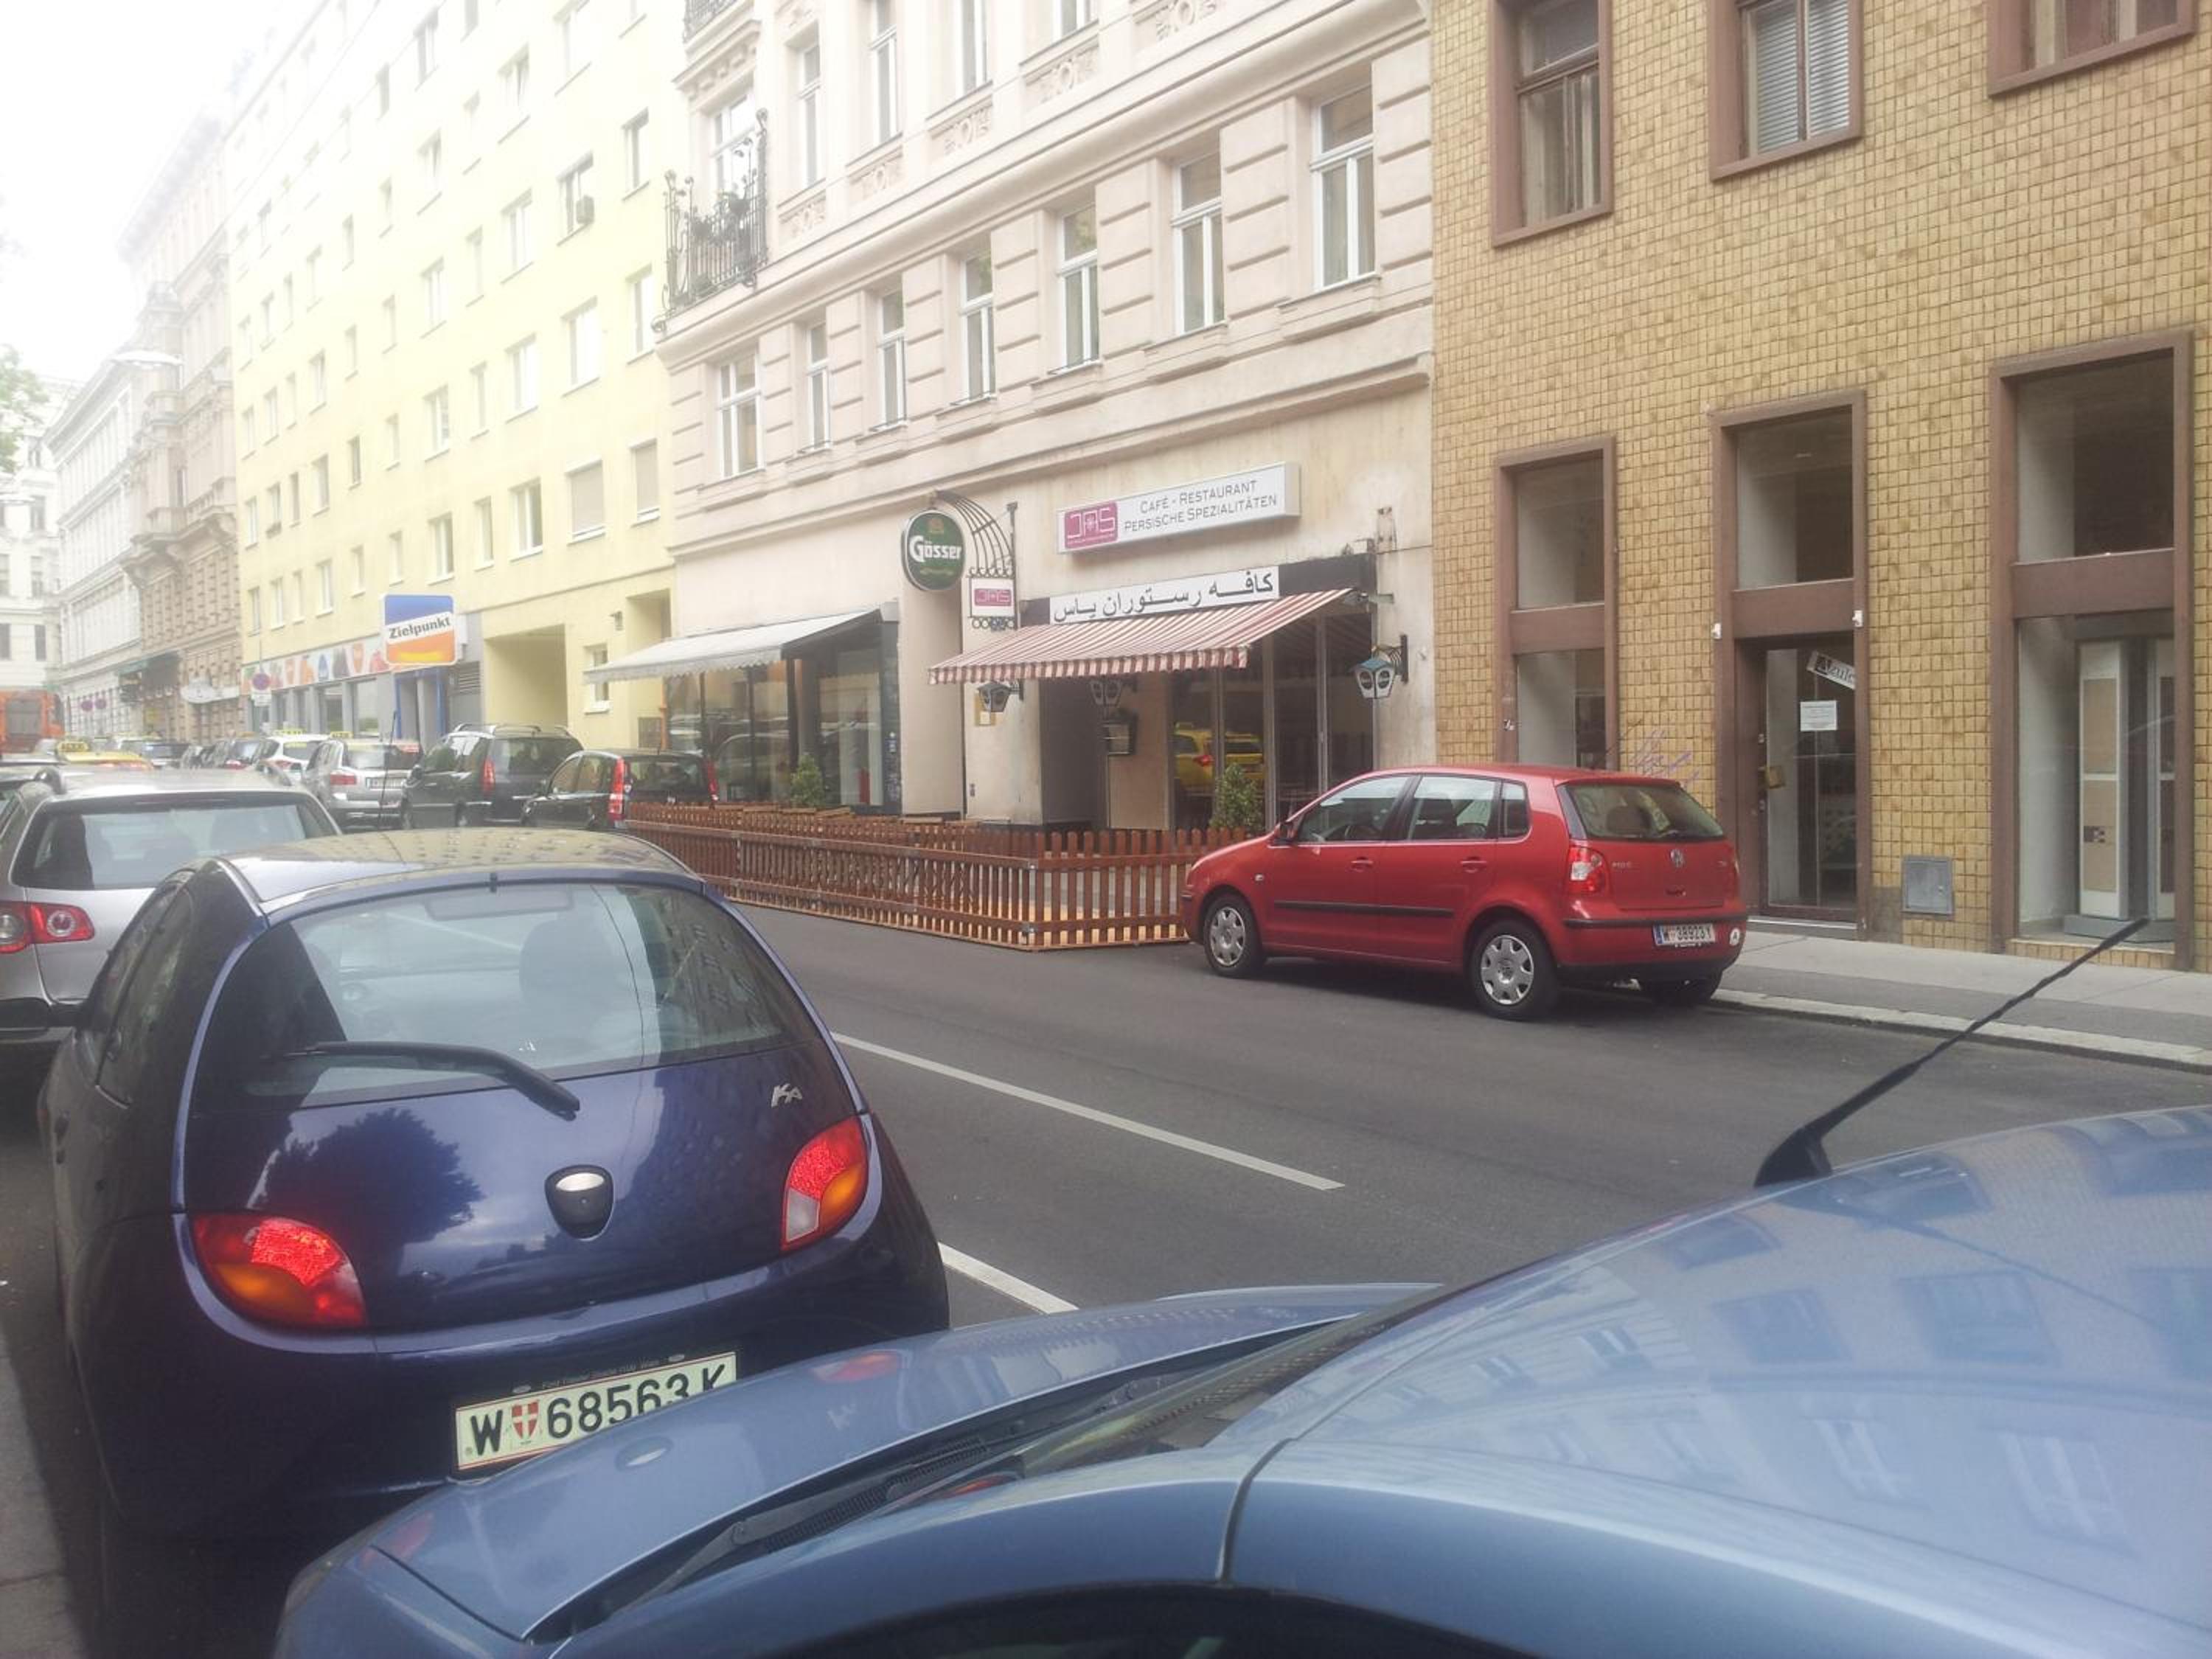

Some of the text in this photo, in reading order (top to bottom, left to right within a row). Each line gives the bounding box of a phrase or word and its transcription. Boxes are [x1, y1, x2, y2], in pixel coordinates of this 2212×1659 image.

[1124, 494, 1277, 532] PERSISCHE SPEZIALITÄTEN
[1140, 497, 1169, 514] CAFÉ
[1179, 480, 1256, 505] RESTAURANT
[909, 535, 961, 563] Gösser
[389, 616, 451, 639] Zielpunkt
[470, 1409, 503, 1456] W
